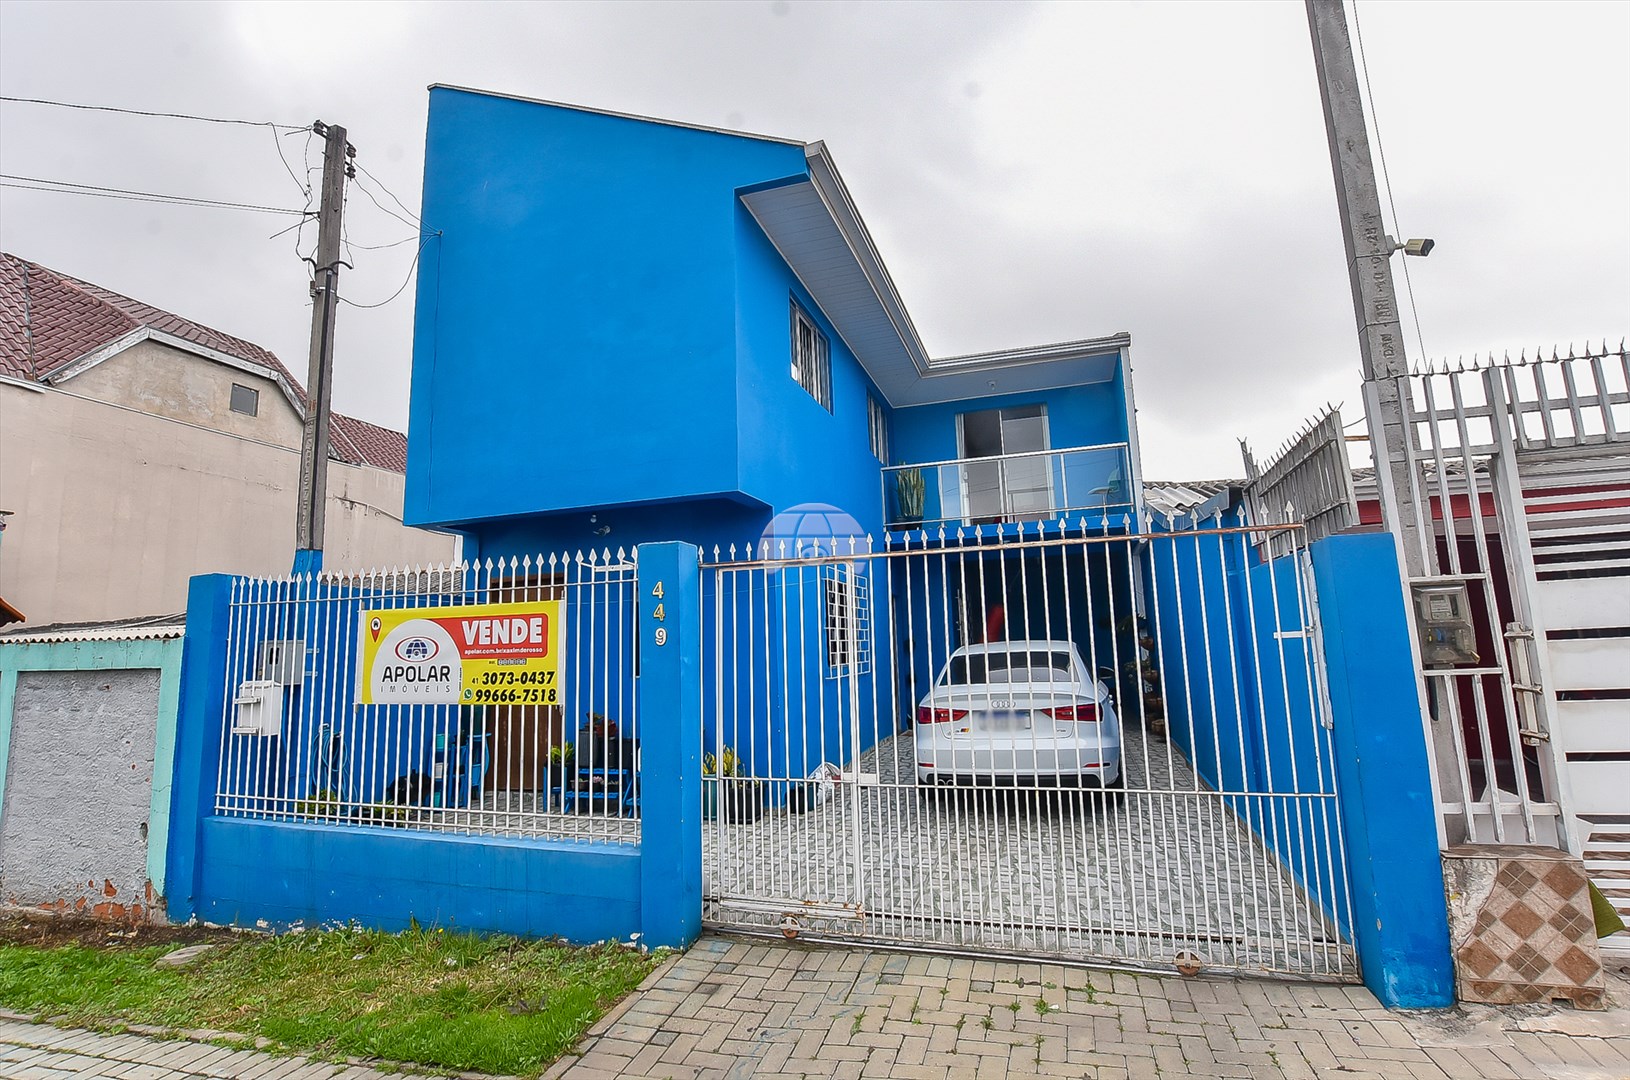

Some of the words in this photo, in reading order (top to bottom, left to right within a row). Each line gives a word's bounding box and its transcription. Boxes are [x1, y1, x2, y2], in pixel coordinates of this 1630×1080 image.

[652, 581, 667, 646] 449
[461, 617, 543, 646] VENDE
[381, 665, 451, 682] APOLAR
[482, 671, 555, 685] 3073-0437
[380, 684, 451, 693] IMÓVEIS
[475, 689, 556, 703] 99666-7518
